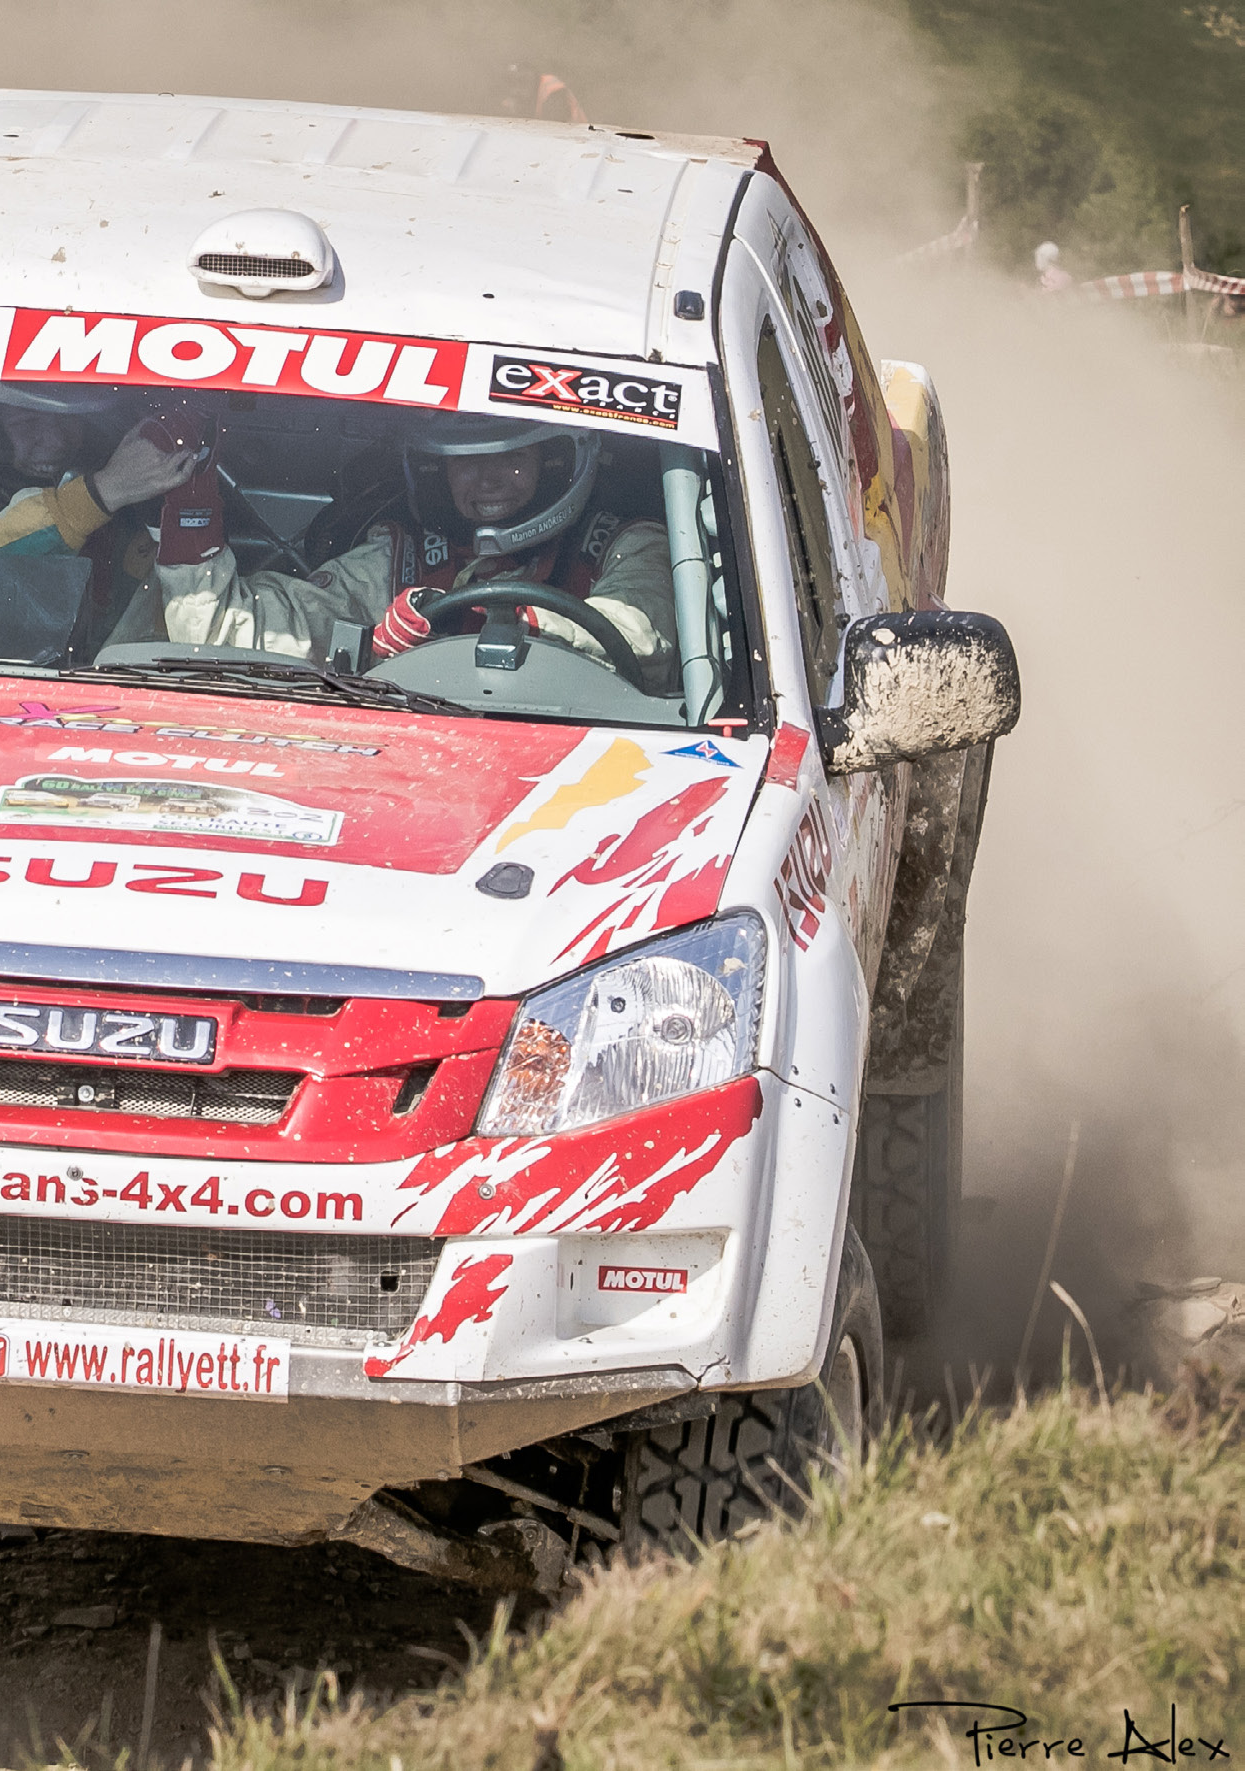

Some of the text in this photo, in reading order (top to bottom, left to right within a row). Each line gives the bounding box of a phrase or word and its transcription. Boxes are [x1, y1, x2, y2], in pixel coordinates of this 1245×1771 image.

[13, 311, 451, 408] MOTUL
[46, 746, 286, 778] MOTUL
[602, 1270, 685, 1291] MOTUL
[25, 1336, 281, 1396] www.rallyett.fr
